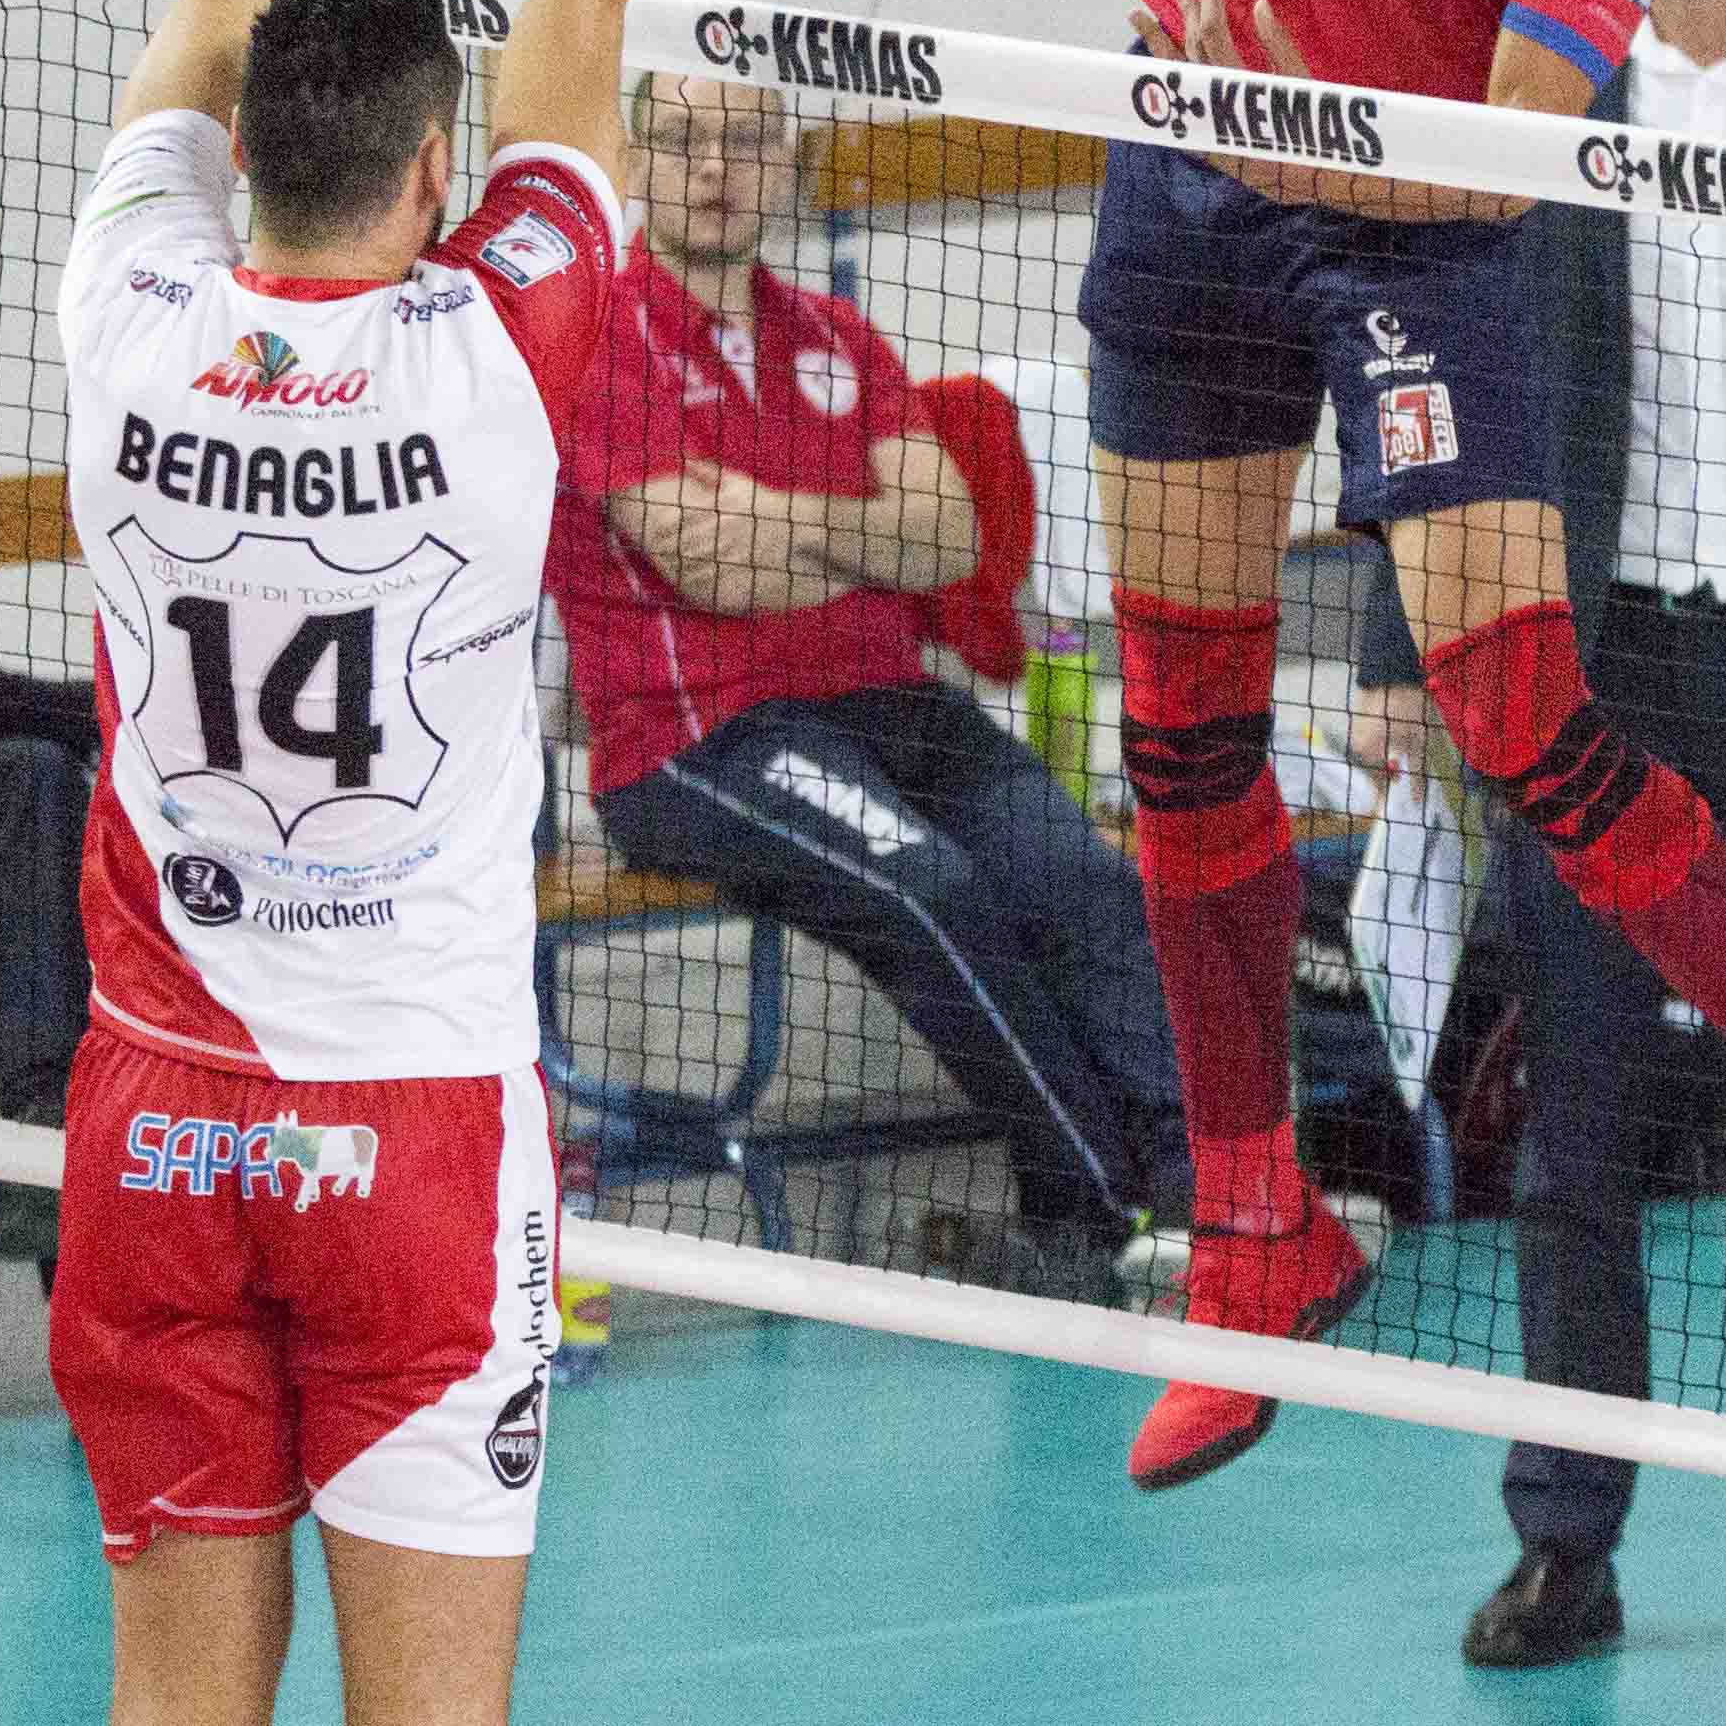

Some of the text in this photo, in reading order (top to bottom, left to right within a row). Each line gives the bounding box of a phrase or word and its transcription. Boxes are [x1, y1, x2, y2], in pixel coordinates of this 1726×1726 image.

[771, 11, 943, 106] KEMAS
[1209, 76, 1385, 167] KEMAS
[116, 411, 451, 519] BENAGLIA
[187, 572, 419, 605] PELLE DI TOSCANA
[166, 594, 384, 789] 14
[120, 1111, 284, 1199] SAPA
